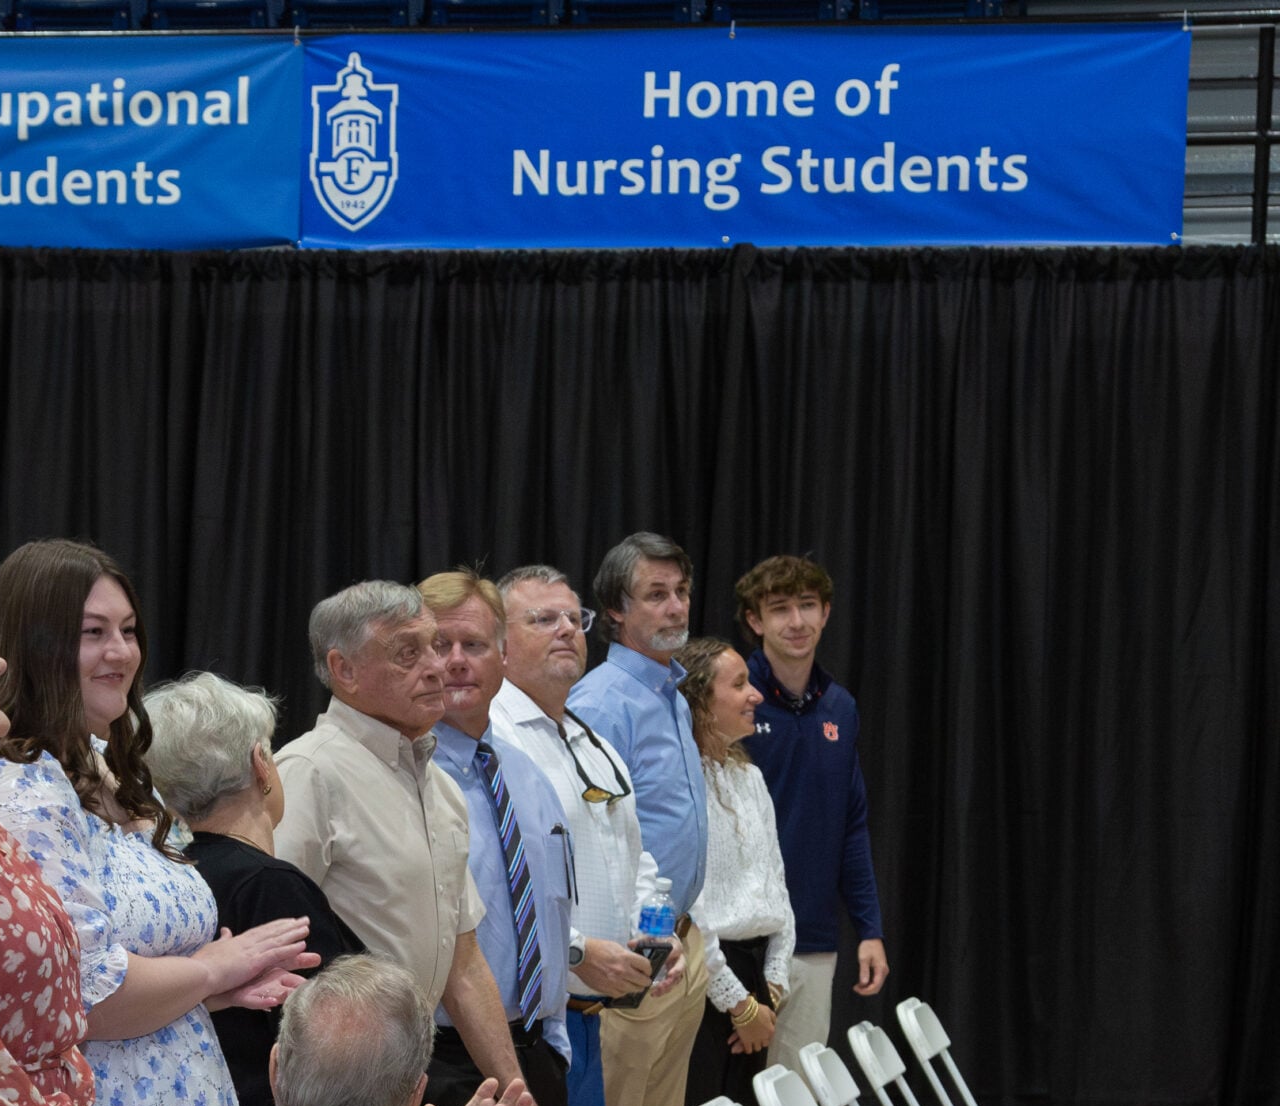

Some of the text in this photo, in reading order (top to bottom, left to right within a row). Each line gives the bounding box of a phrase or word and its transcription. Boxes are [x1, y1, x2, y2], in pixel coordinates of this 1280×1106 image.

[643, 63, 900, 118] Home of
[344, 156, 364, 185] F
[513, 141, 1028, 211] Nursing Students
[341, 200, 366, 209] 1942
